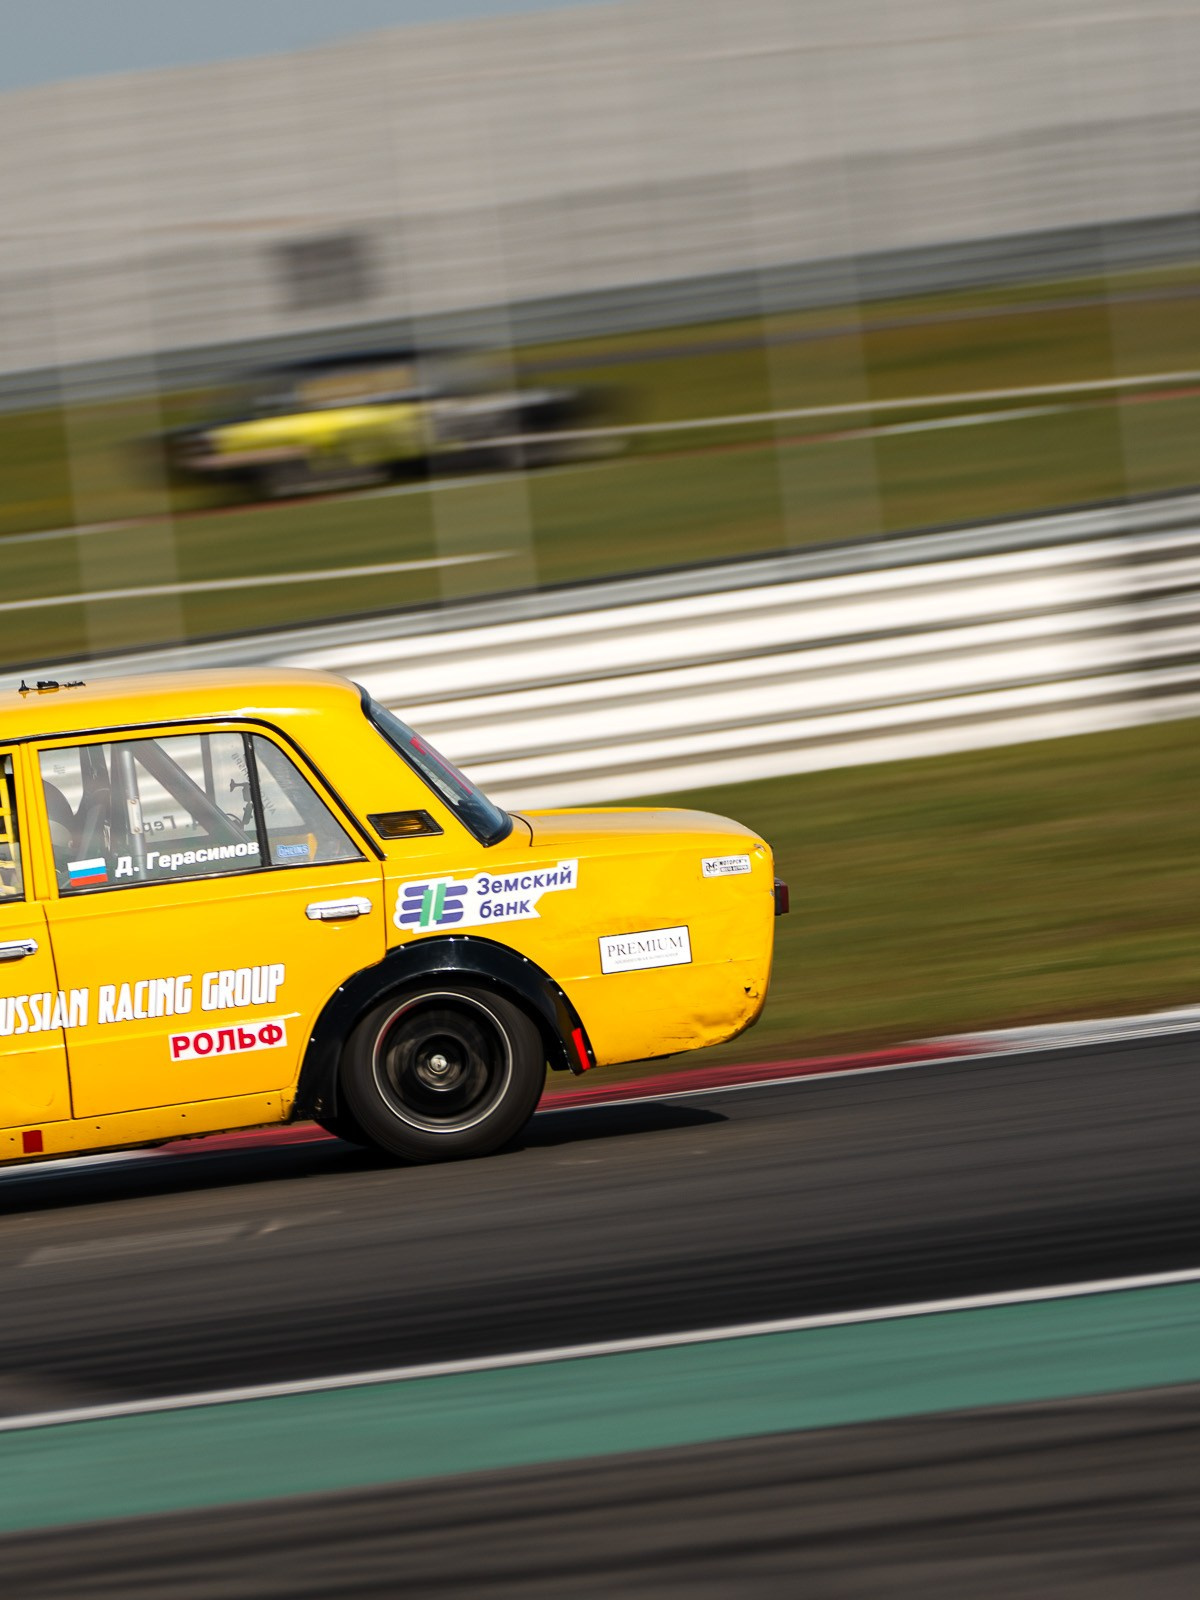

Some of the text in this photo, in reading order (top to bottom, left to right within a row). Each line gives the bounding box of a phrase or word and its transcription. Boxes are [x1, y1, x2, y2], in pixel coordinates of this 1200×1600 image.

[115, 842, 260, 878] Д. Герасимов
[476, 865, 572, 896] Земский
[479, 900, 532, 919] банк
[607, 936, 683, 957] PREMIUM
[97, 974, 193, 1025] RACING
[200, 962, 286, 1012] GROUP
[171, 1023, 284, 1059] РОЛЬФ
